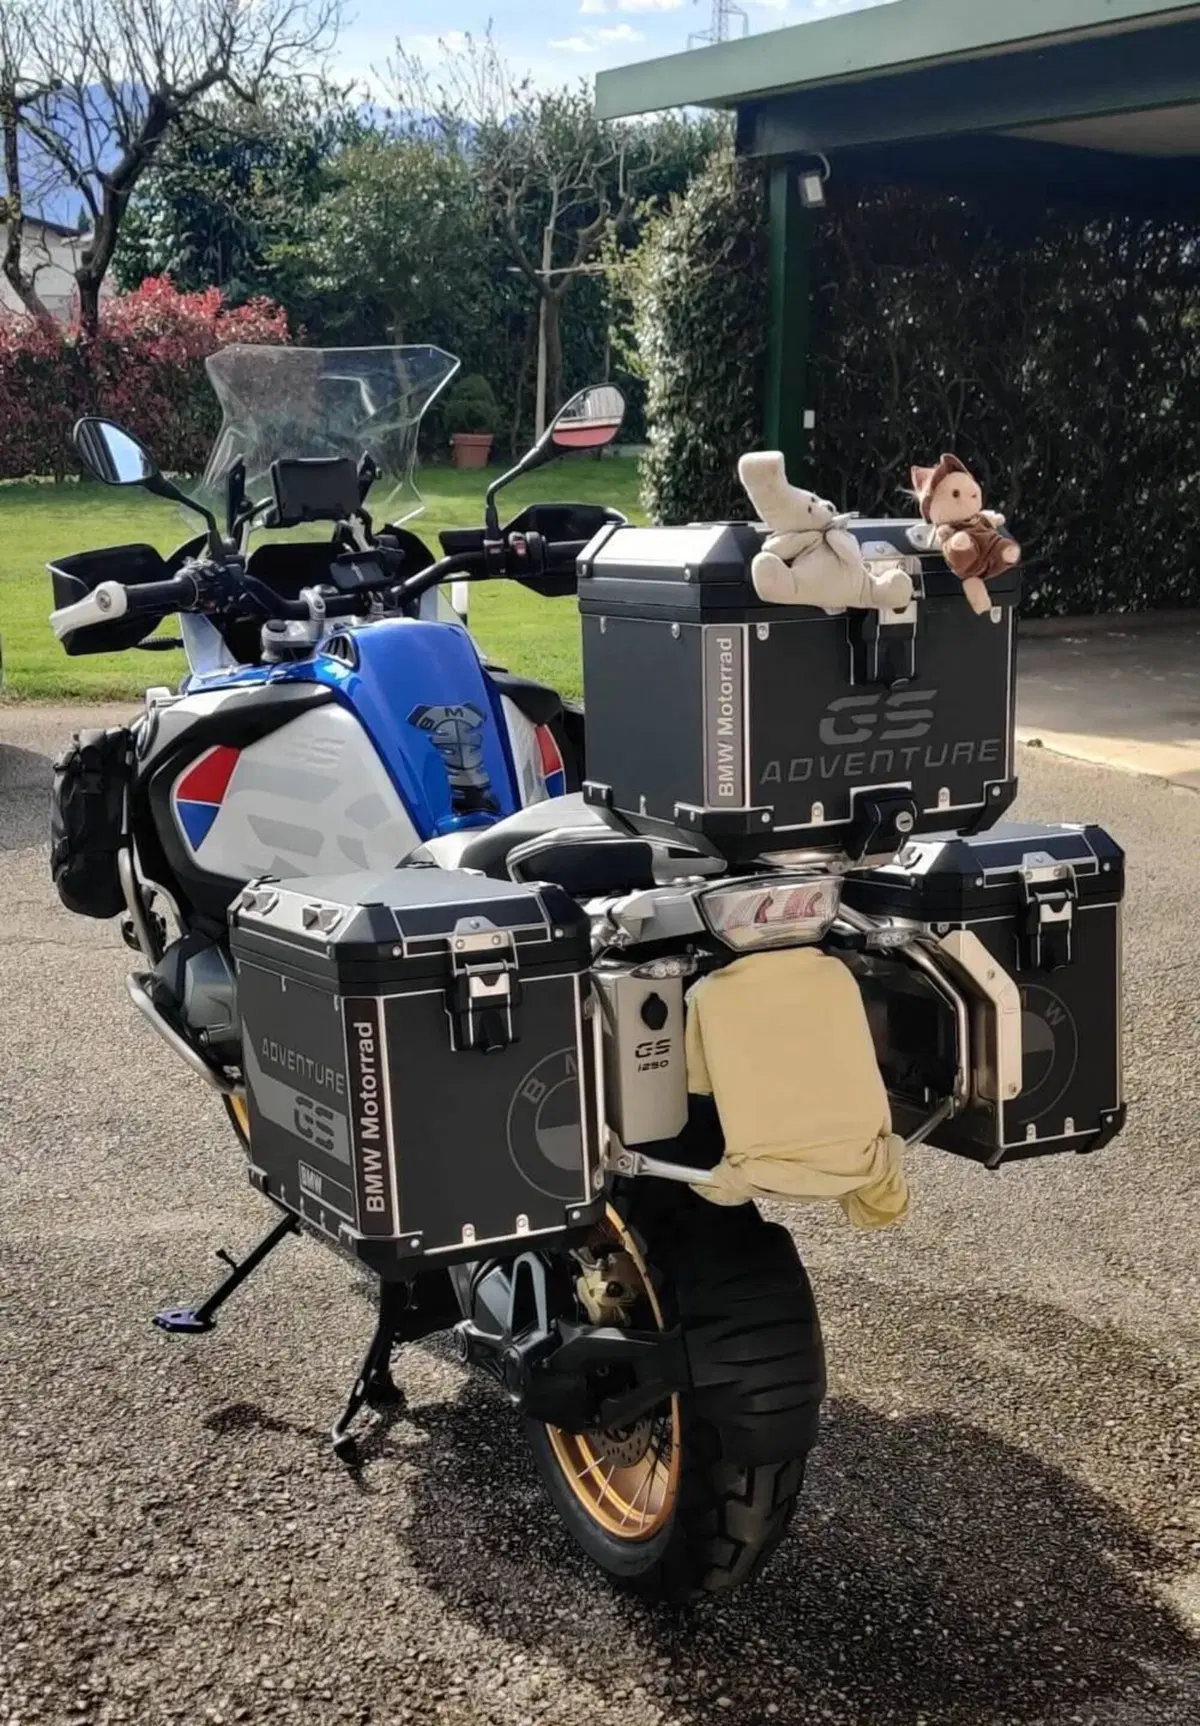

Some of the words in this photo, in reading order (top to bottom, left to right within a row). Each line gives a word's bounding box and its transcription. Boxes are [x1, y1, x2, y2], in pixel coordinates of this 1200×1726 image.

[717, 637, 733, 737] Motorrad
[819, 689, 938, 746] GS
[717, 741, 734, 797] BMW
[760, 738, 1001, 786] ADVENTURE
[262, 1037, 345, 1096] ADVENTURE
[635, 1038, 672, 1058] GS
[637, 1059, 669, 1073] 1250
[353, 1021, 380, 1140] Motorrad
[294, 1095, 335, 1151] GS
[300, 1167, 323, 1196] BMW
[363, 1147, 385, 1213] BMW
